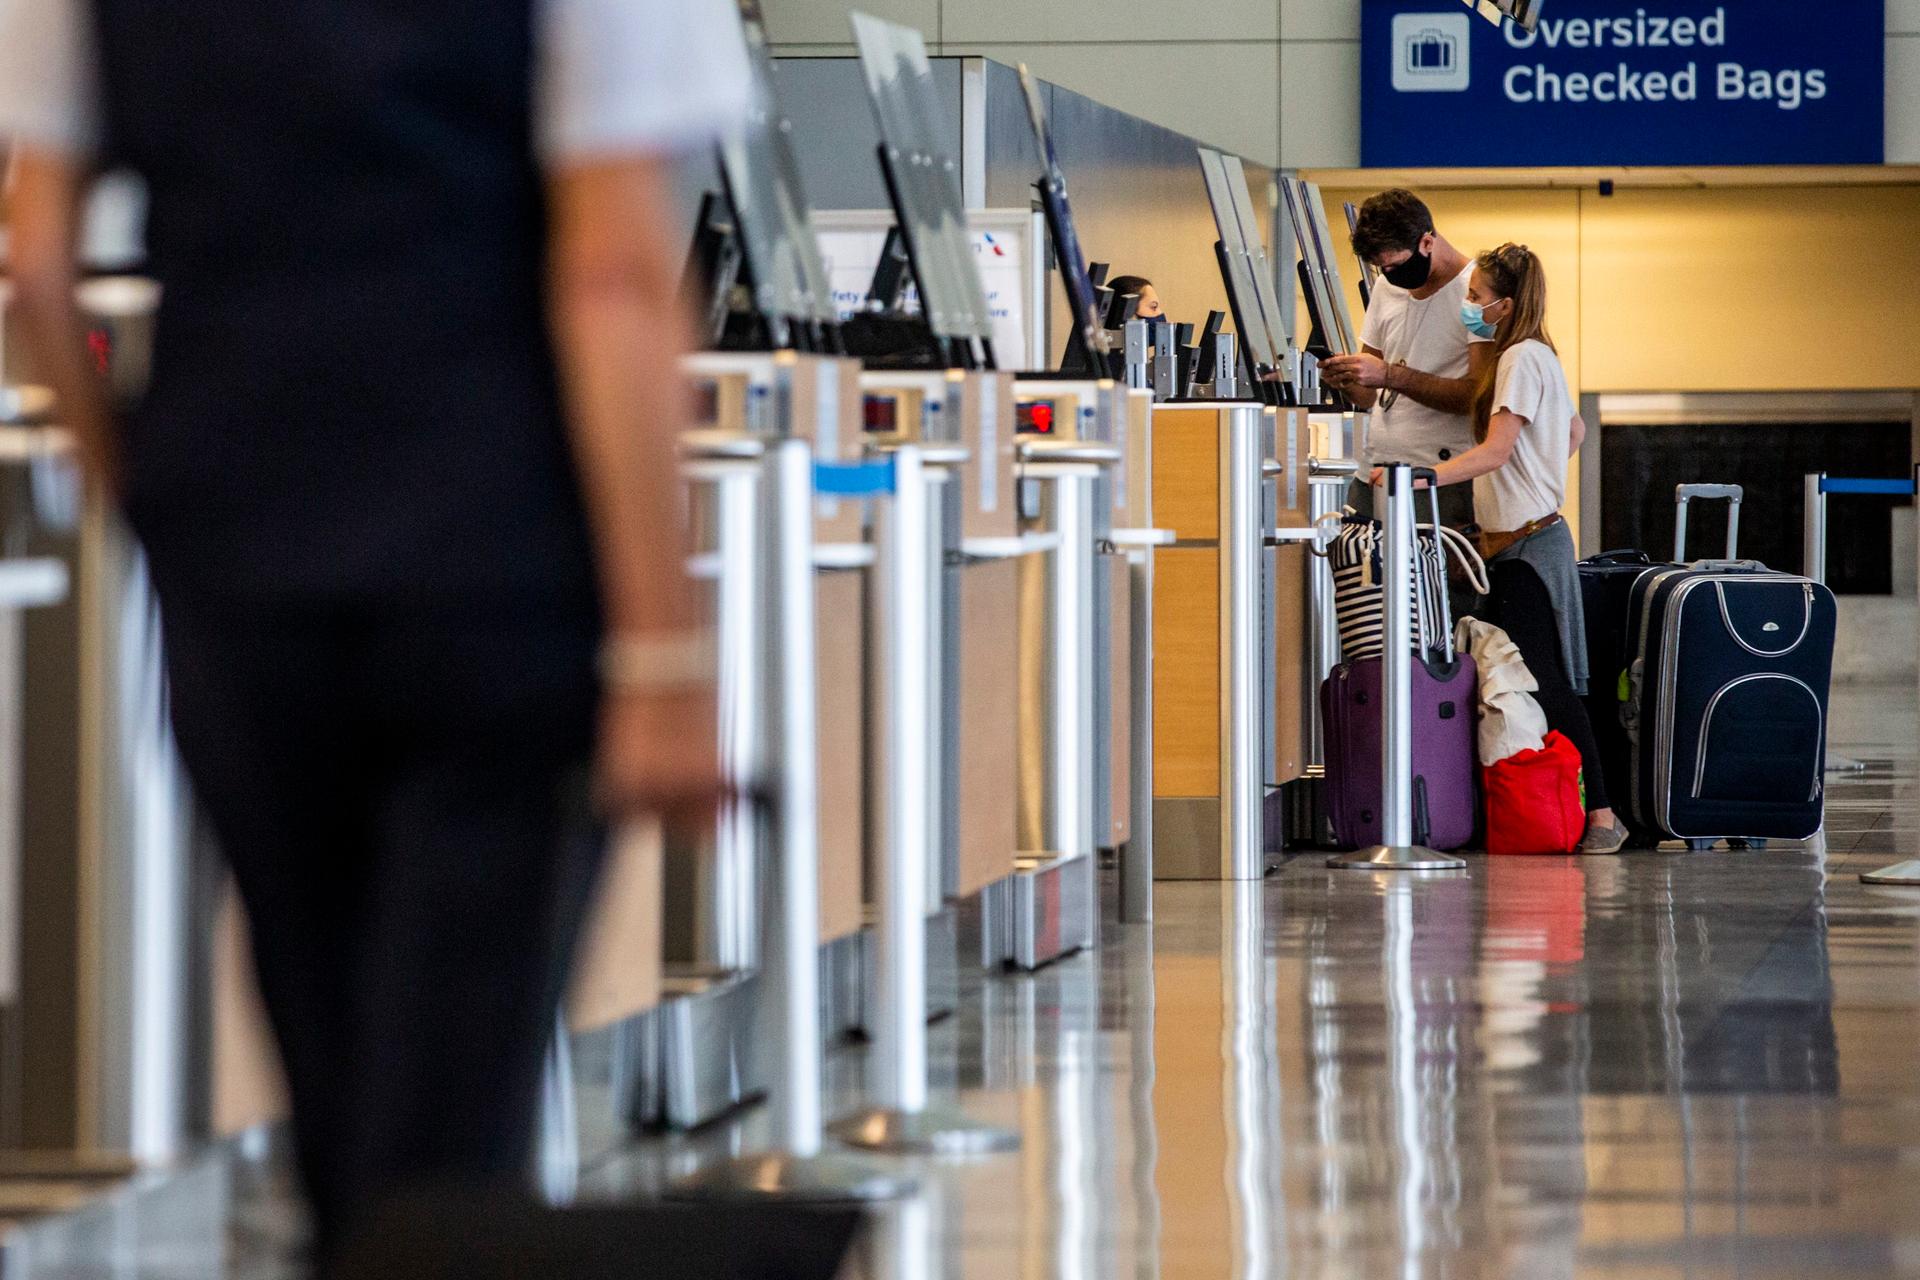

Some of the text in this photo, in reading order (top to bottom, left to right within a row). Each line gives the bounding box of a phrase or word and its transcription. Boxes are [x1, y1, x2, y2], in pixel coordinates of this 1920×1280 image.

[1503, 7, 1725, 49] Oversized
[1503, 61, 1827, 110] Checked Bags
